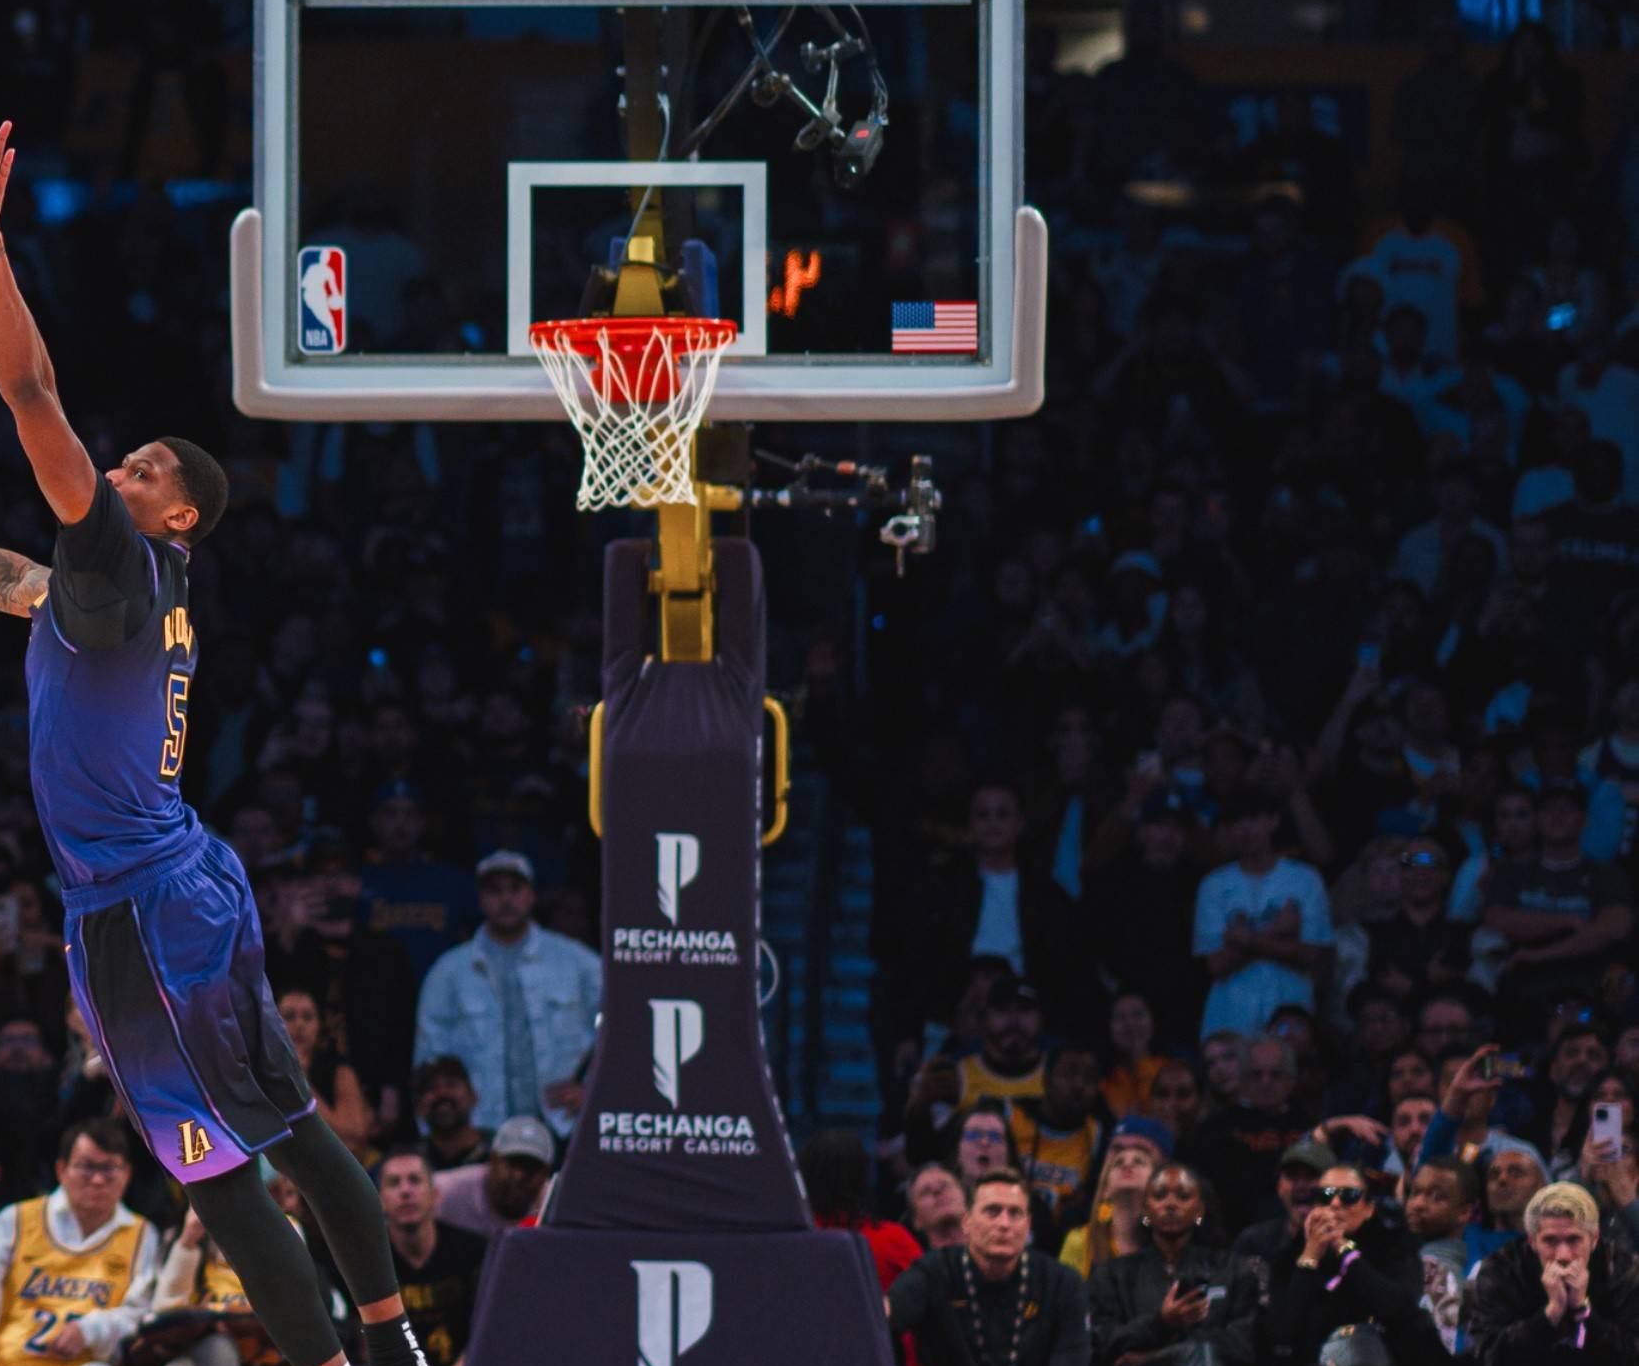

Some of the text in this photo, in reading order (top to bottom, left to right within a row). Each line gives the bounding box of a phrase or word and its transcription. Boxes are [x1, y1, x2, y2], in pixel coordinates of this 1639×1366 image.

[305, 329, 328, 347] NBA
[160, 672, 190, 777] 5
[613, 928, 737, 951] PECHANGA
[613, 950, 738, 965] RESORT CASINO
[599, 1112, 755, 1137] PECHANGA
[176, 1119, 214, 1167] LA
[599, 1137, 756, 1155] RESORT CASINO
[20, 1266, 110, 1309] LAKERS
